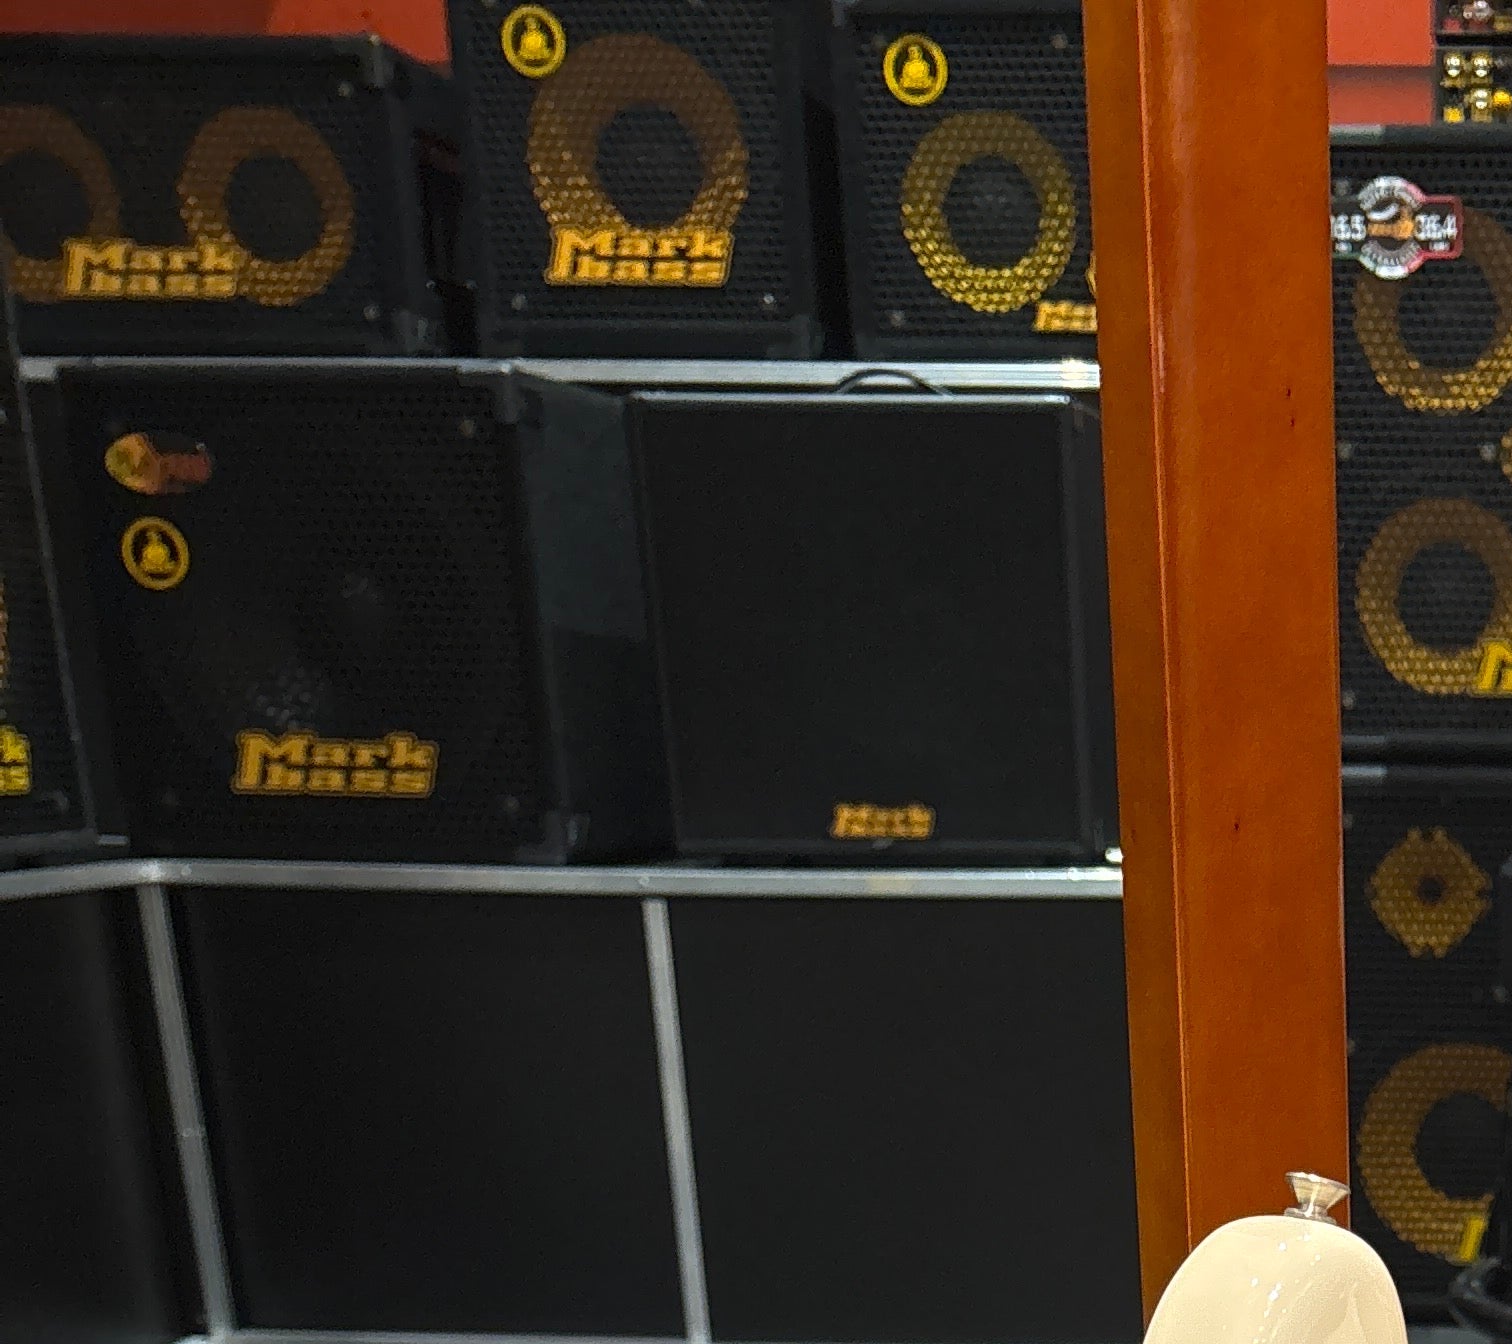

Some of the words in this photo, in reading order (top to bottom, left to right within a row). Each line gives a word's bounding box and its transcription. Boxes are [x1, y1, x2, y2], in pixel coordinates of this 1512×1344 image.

[66, 243, 236, 292] Mark
[549, 230, 725, 280] Mark
[239, 733, 434, 787] Mark
[266, 763, 428, 791] bass
